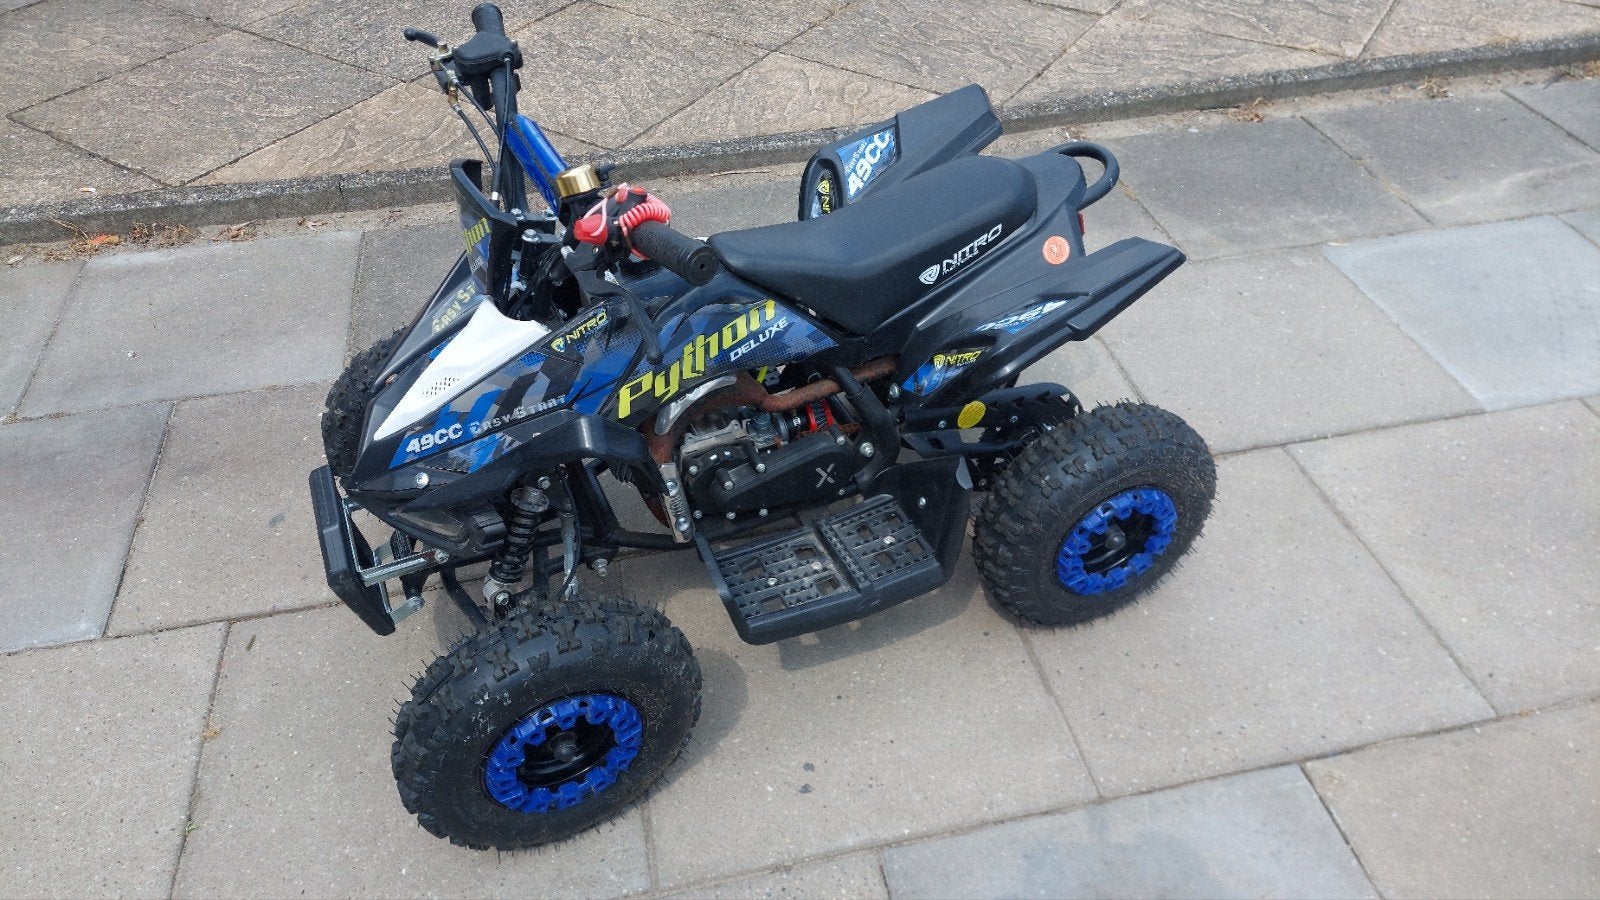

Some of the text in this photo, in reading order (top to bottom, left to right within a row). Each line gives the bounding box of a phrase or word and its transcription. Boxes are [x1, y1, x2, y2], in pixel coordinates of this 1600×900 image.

[848, 131, 890, 196] 49CC
[942, 223, 1003, 272] NITRO
[566, 309, 607, 344] NITRO
[729, 316, 789, 362] DELUXE
[618, 299, 777, 420] Python
[945, 350, 982, 366] NITRO
[405, 422, 463, 454] 49CC
